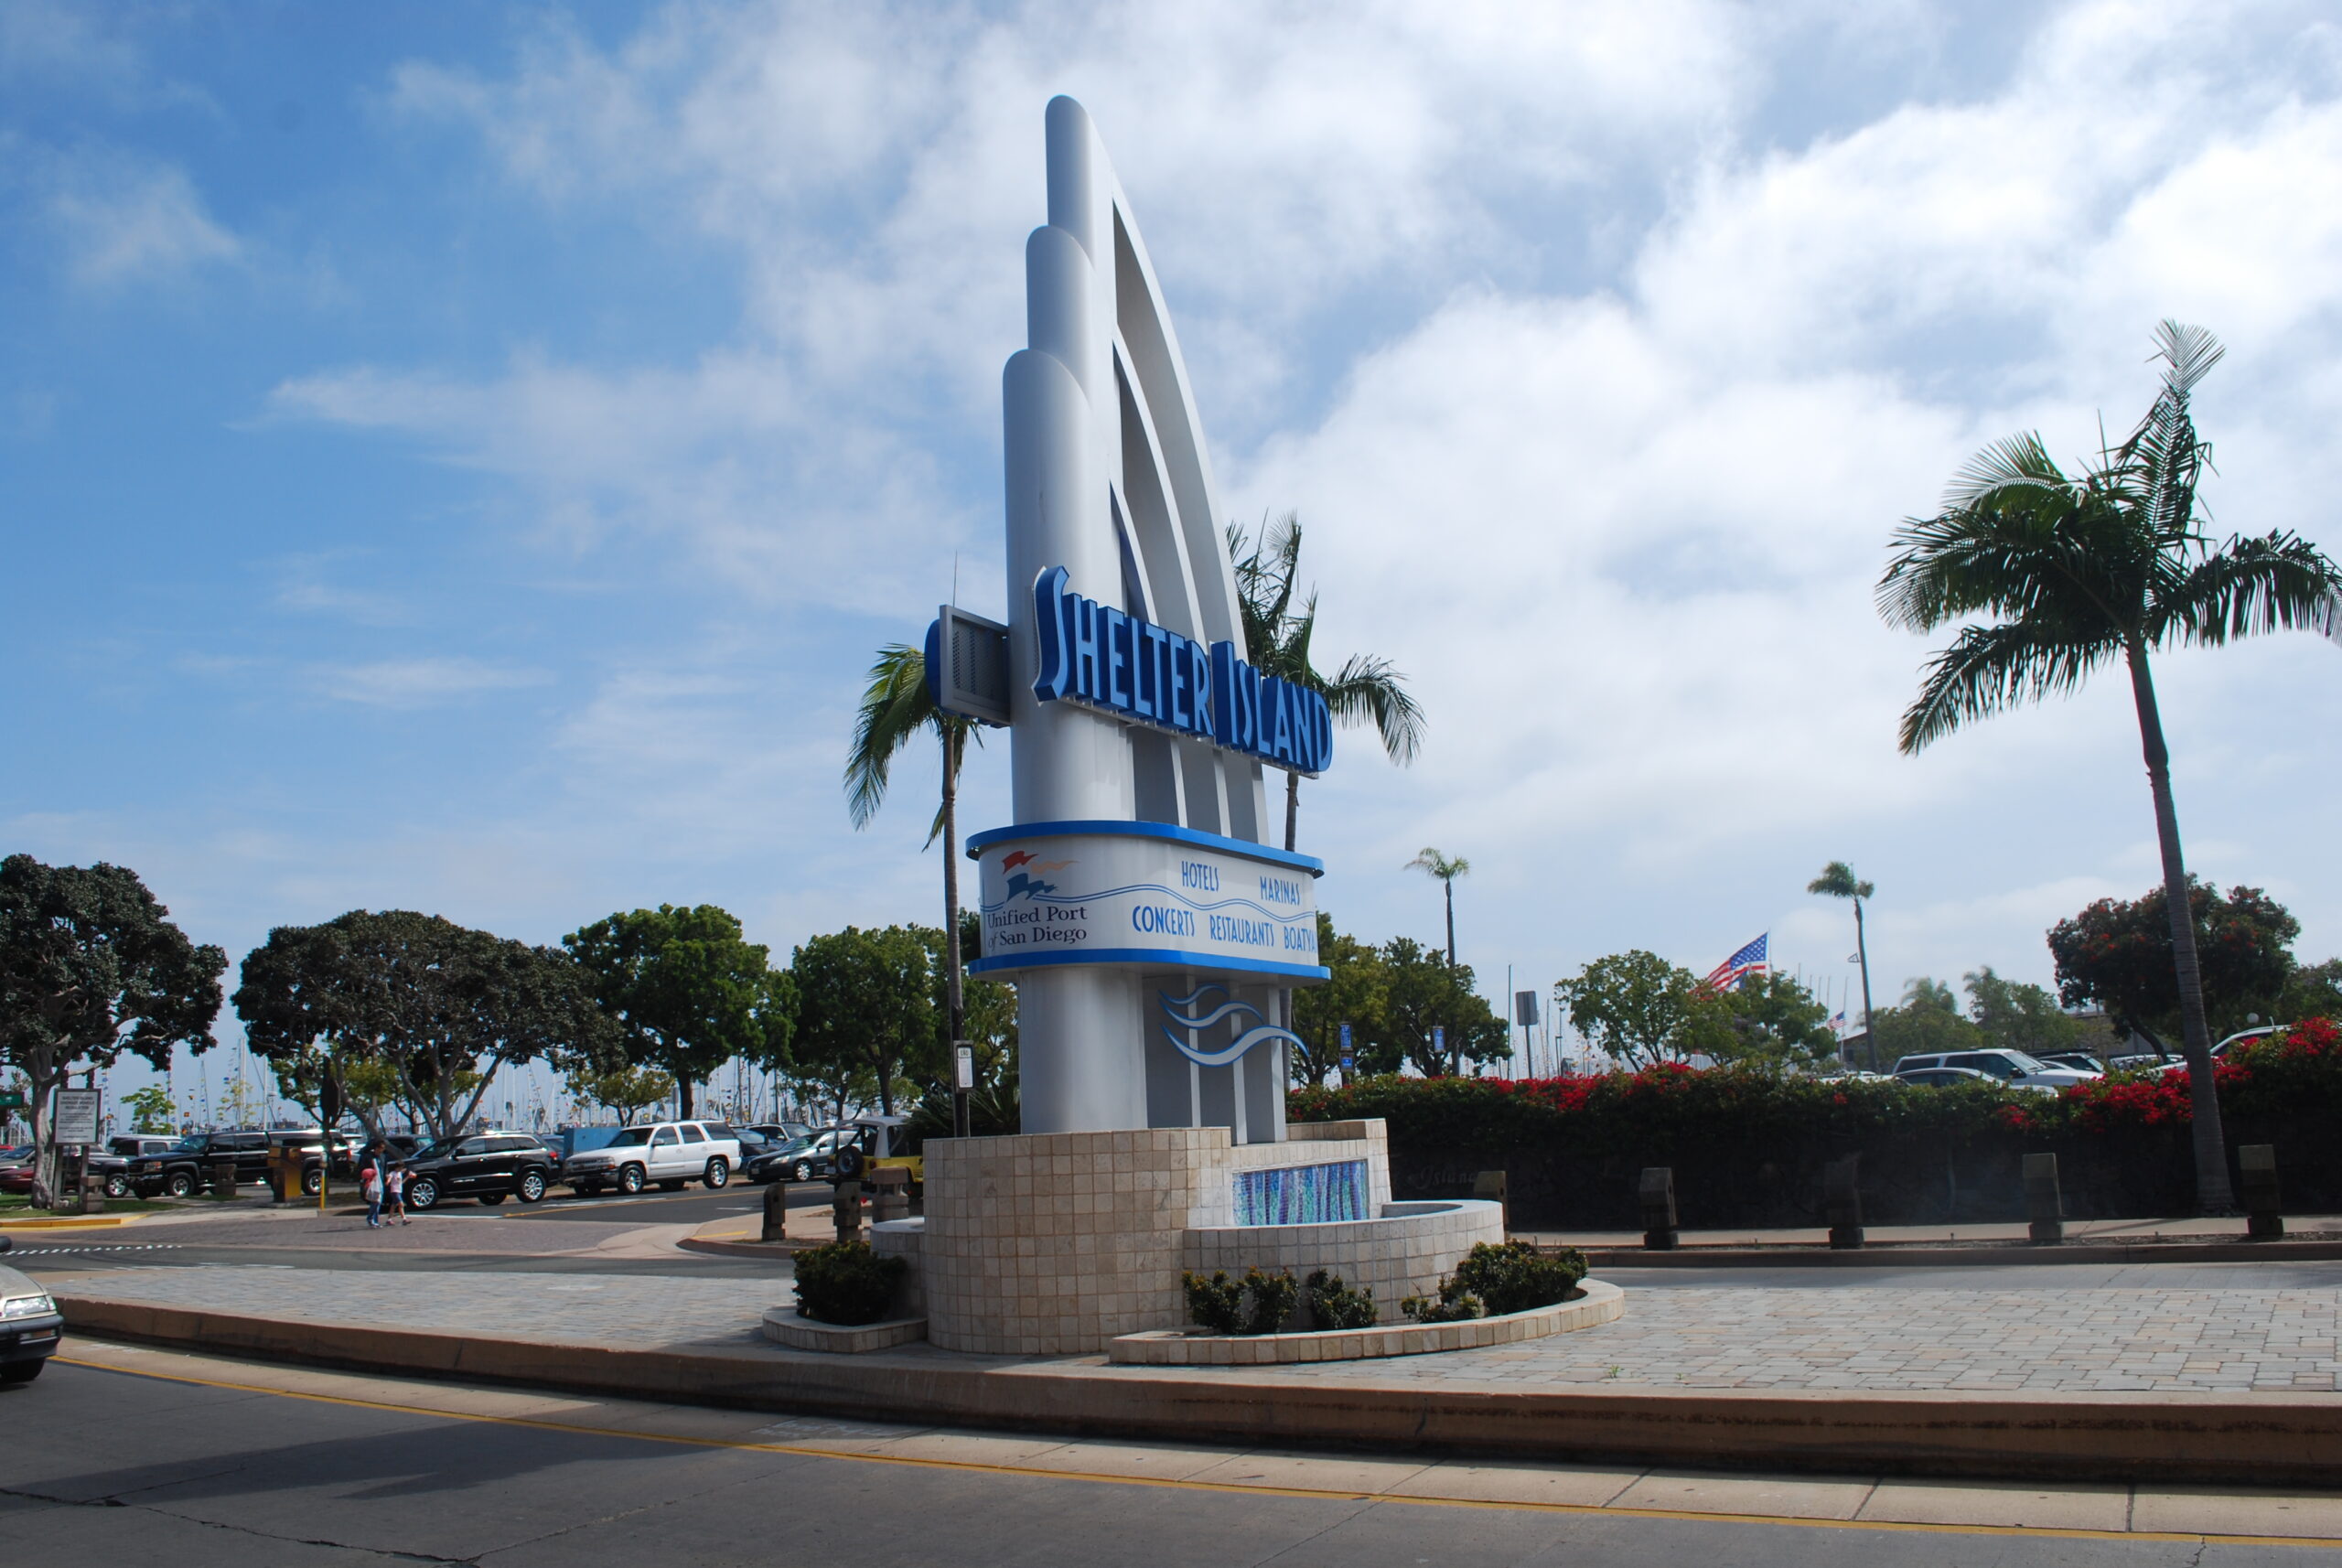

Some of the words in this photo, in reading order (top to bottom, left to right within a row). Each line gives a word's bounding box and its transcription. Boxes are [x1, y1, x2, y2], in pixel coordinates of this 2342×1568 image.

[1039, 565, 1215, 737] SHELTER
[1213, 640, 1333, 773] ISLAND
[1181, 860, 1219, 892] HOTELS
[1260, 875, 1300, 906] MARINAS
[988, 907, 1041, 929] Unified
[1047, 906, 1088, 922] Port
[1132, 905, 1195, 938] CONCERTS
[1209, 914, 1274, 947] RESTAURANTS
[988, 931, 998, 951] of
[999, 930, 1027, 946] San
[1032, 926, 1088, 945] Diego
